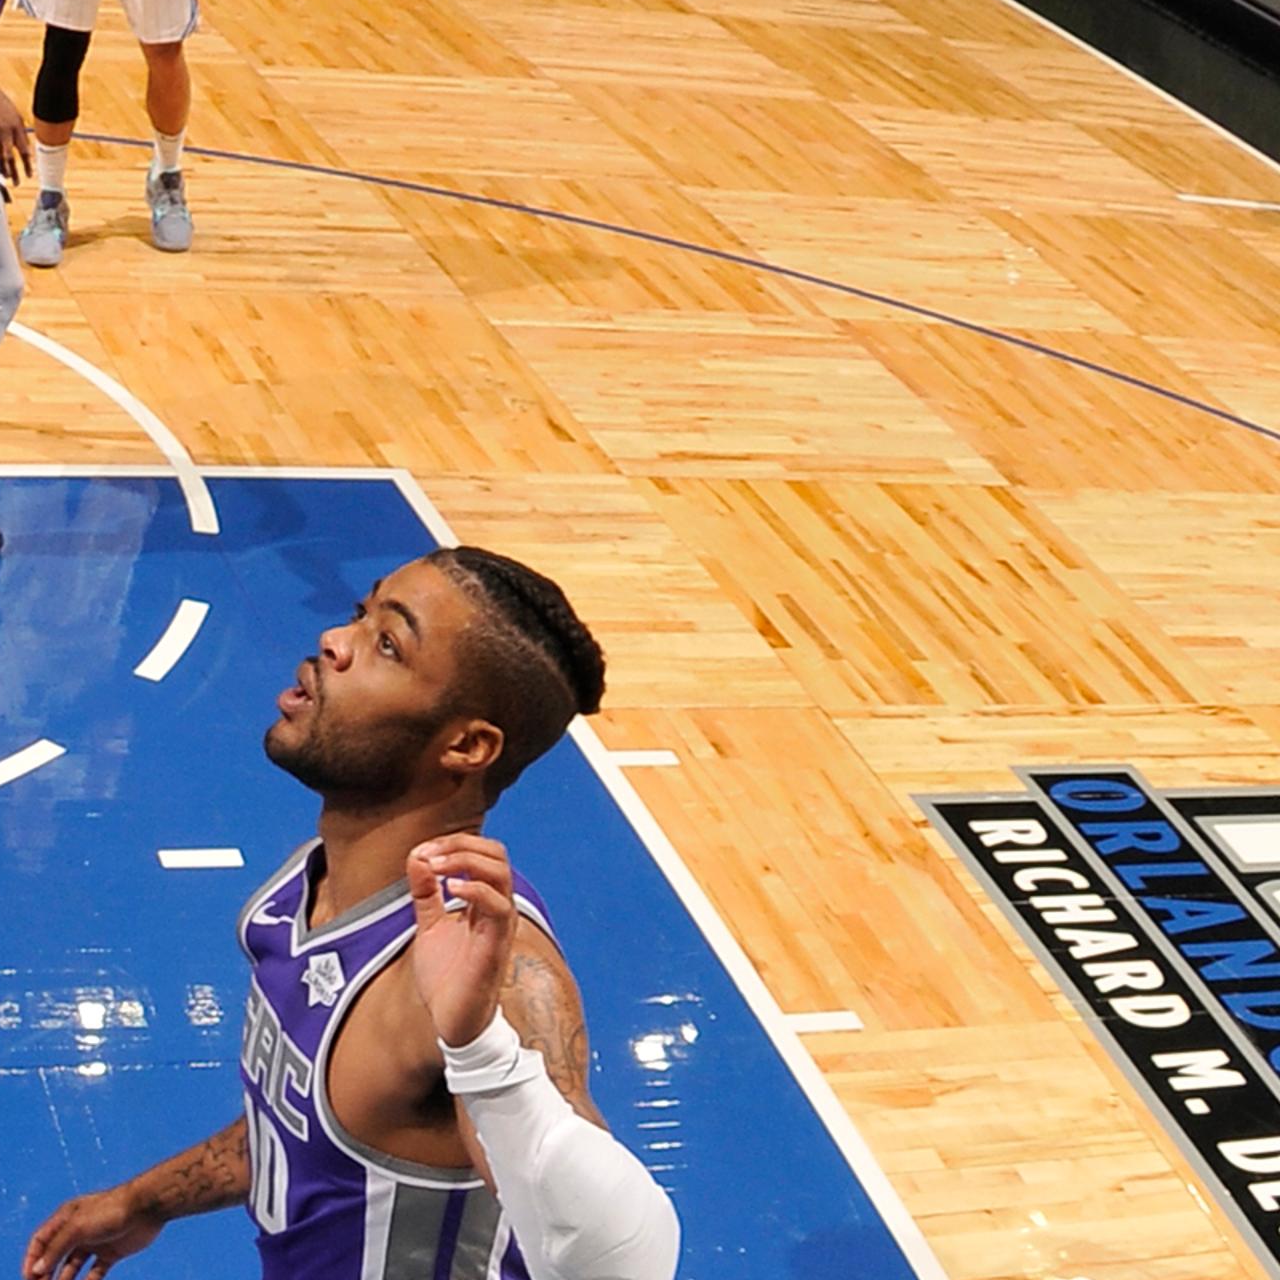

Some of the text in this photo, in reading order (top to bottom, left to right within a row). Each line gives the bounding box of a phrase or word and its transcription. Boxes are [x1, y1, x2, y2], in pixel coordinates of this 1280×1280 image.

[968, 818, 1191, 1030] RICHARD
[1150, 1048, 1247, 1115] M.
[1048, 779, 1280, 1074] ORLAND
